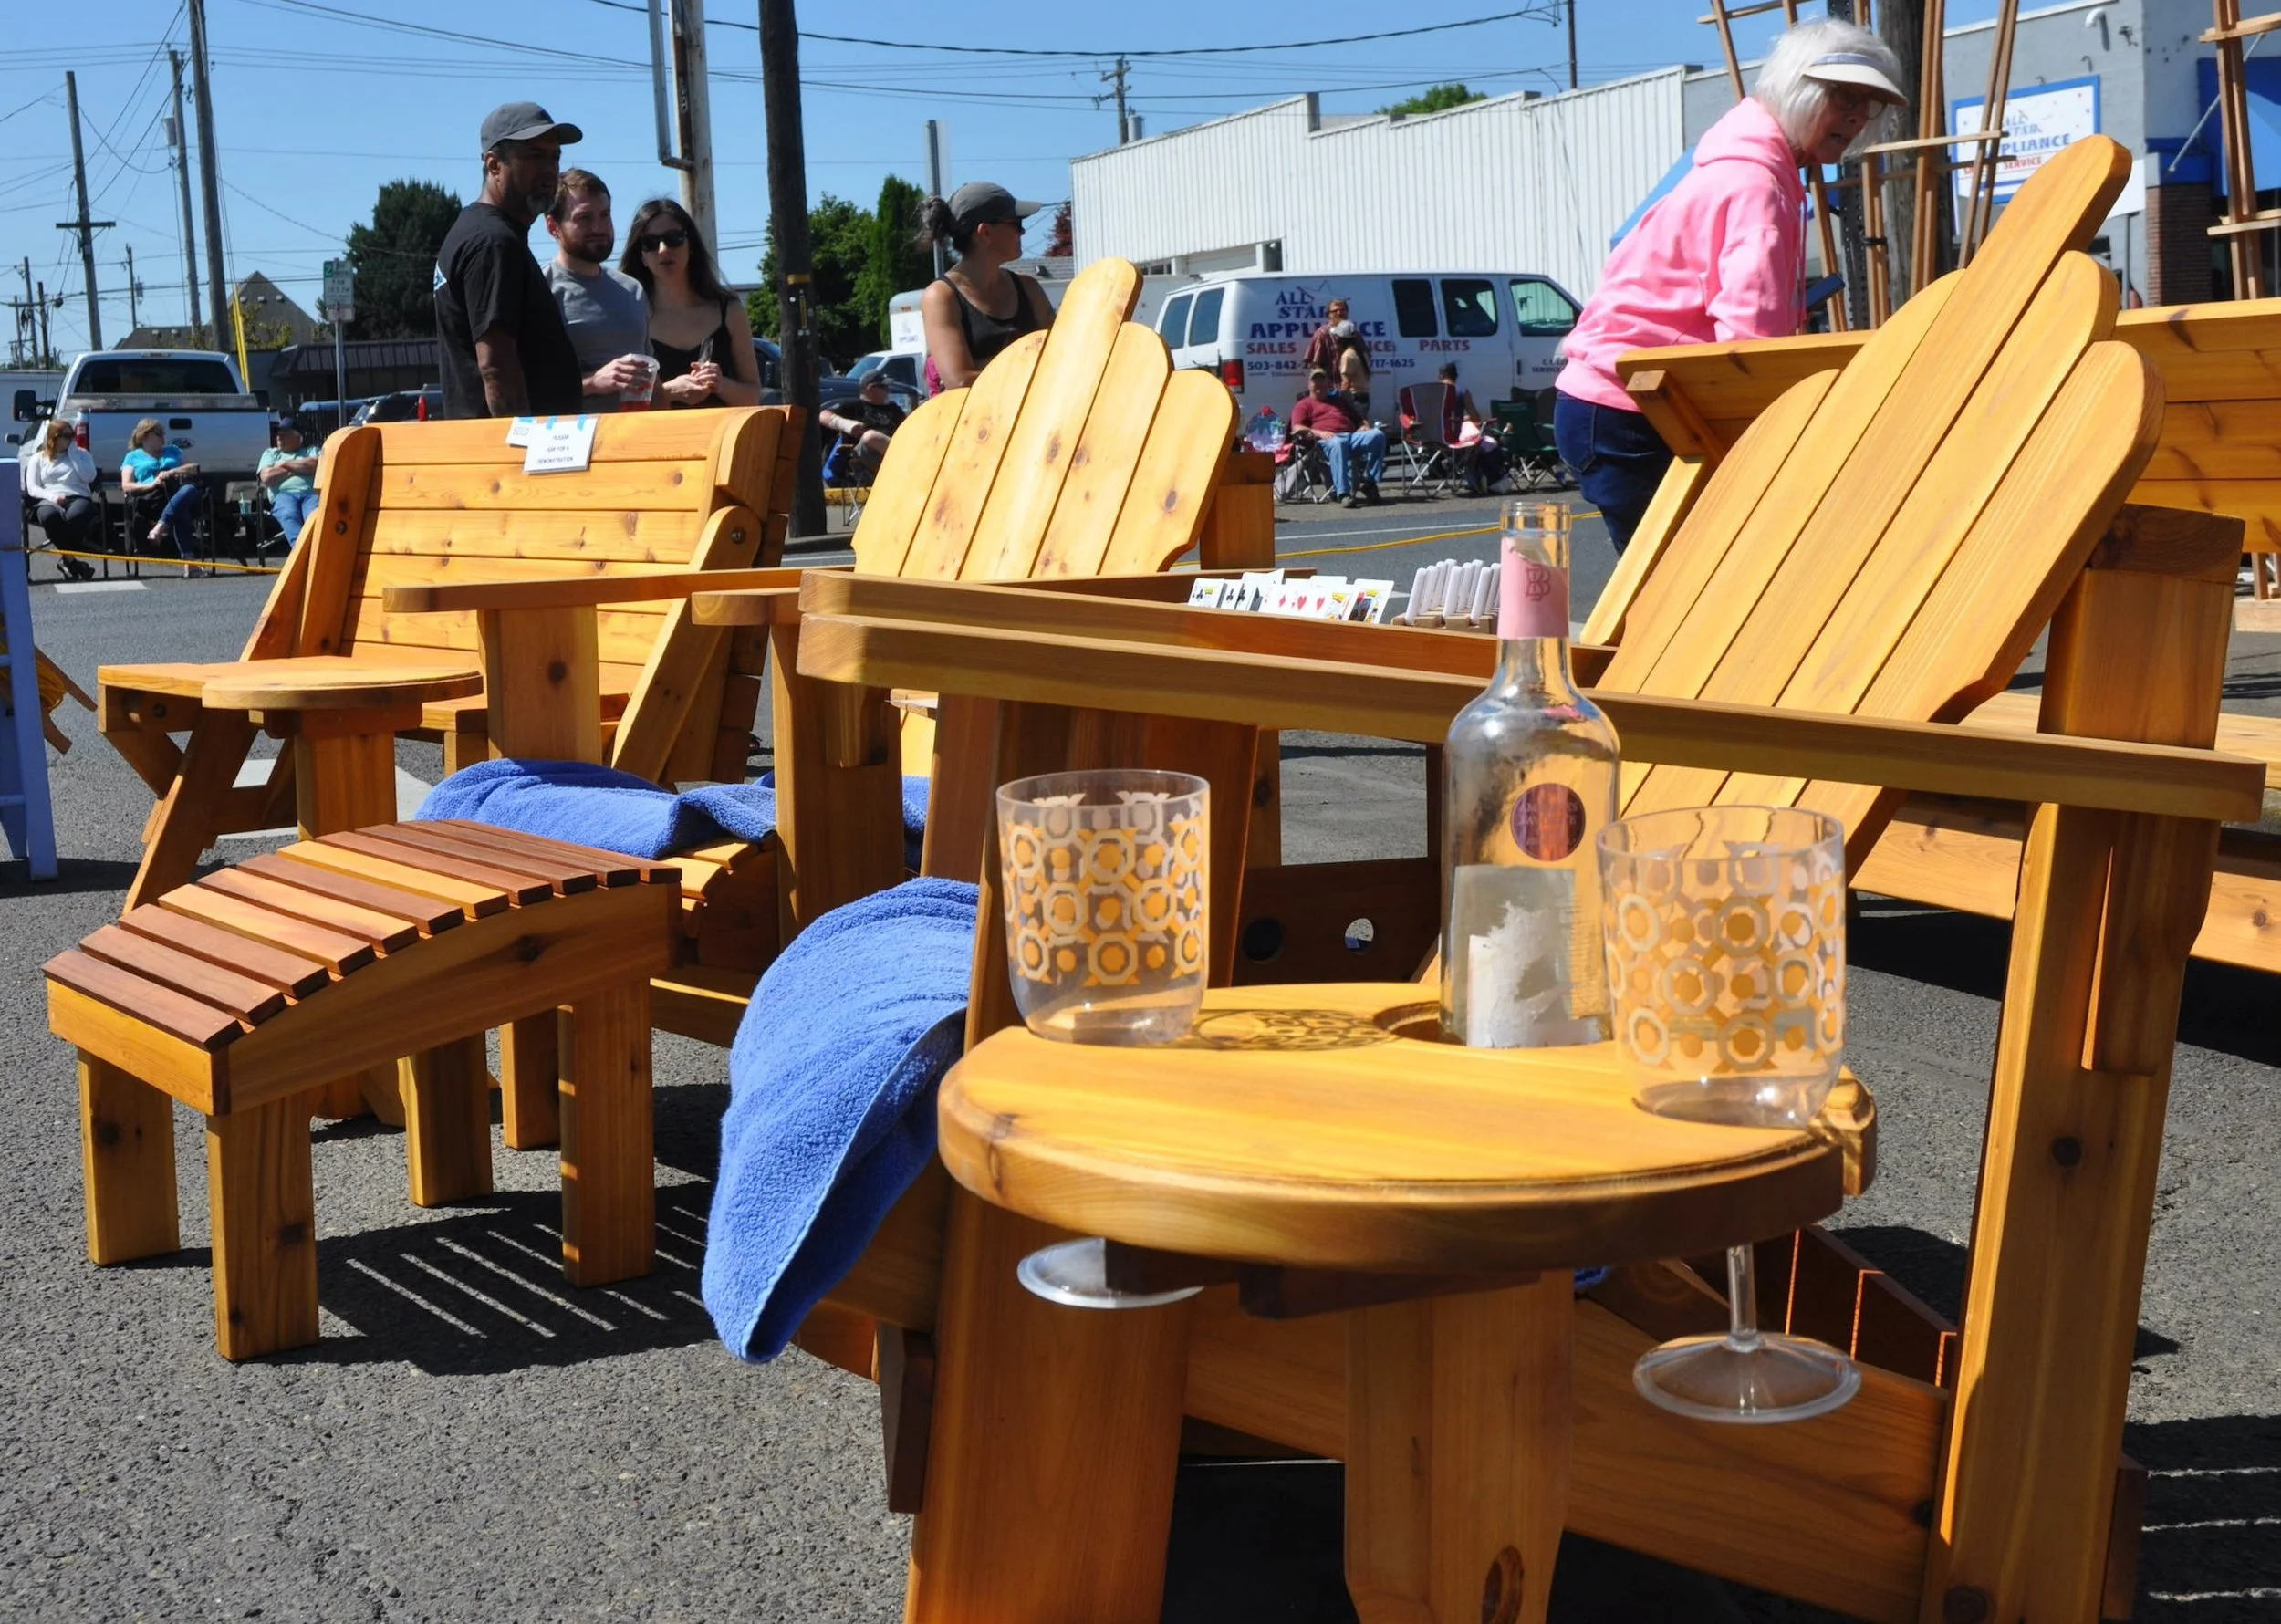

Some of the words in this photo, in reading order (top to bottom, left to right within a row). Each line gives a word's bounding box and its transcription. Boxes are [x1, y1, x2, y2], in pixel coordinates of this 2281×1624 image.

[2001, 133, 2071, 155] PLIANCE
[2004, 157, 2042, 170] SERVICE
[1276, 291, 1309, 306] ALL
[1246, 341, 1297, 355] SALES
[1419, 339, 1471, 352] PARTS
